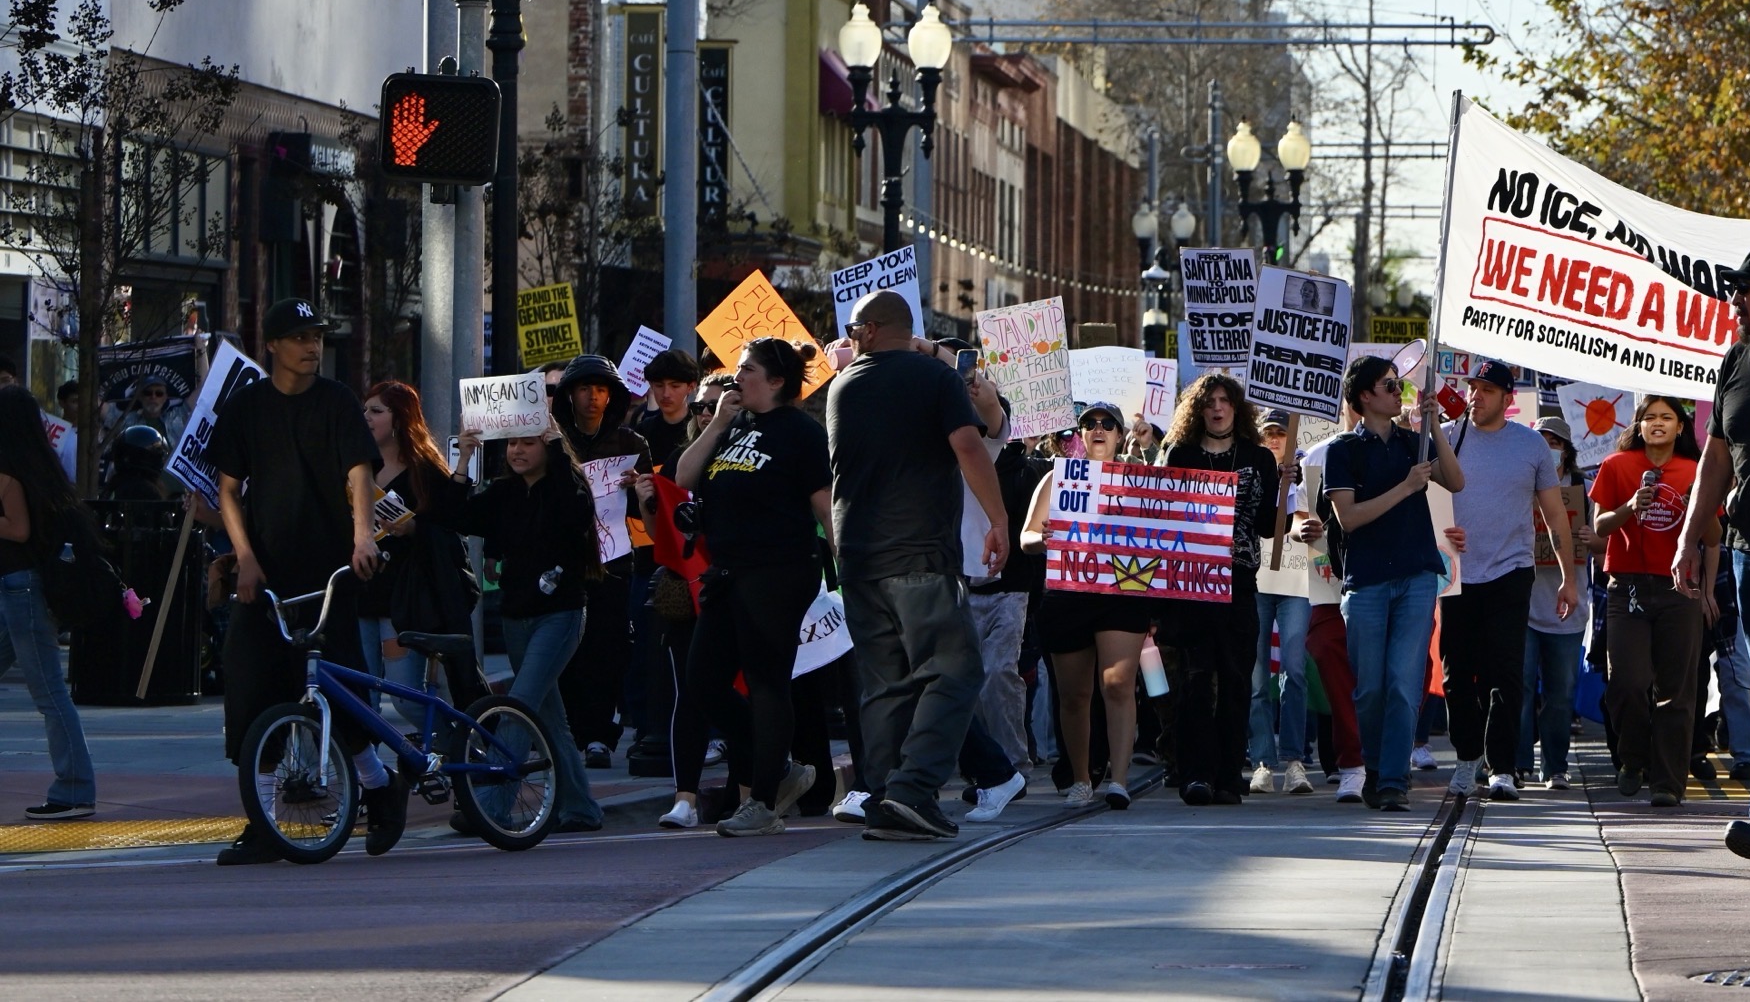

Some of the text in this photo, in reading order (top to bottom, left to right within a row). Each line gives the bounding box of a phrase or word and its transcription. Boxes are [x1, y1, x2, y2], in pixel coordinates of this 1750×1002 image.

[630, 30, 656, 44] CAFÉ
[1487, 168, 1539, 218] NO
[1540, 183, 1602, 240] ICE,
[834, 246, 913, 287] KEEP YOUR
[1184, 258, 1253, 281] SANTA ANA
[551, 286, 570, 301] THE
[836, 265, 917, 303] CITY CLEAN
[1186, 285, 1255, 304] MINNEAPOLIS
[1481, 239, 1537, 297] WE
[1537, 253, 1634, 320] NEED
[1637, 282, 1665, 333] A
[518, 301, 573, 326] GENERAL
[744, 284, 797, 337] FUCK
[1188, 312, 1253, 328] STOP
[525, 323, 573, 348] STRIKE!
[982, 311, 1039, 350] STAND
[1041, 306, 1063, 342] UP
[1190, 329, 1208, 350] ICE
[1208, 329, 1250, 351] TERRO
[1257, 308, 1348, 349] JUSTICE FOR
[1373, 321, 1426, 337] EXPAND THE
[1462, 306, 1505, 335] PARTY
[1506, 317, 1535, 341] FOR
[1537, 324, 1618, 361] SOCIALISM
[1620, 348, 1655, 372] AND
[1011, 343, 1034, 360] FOR
[1254, 341, 1344, 375] RENEE
[154, 364, 190, 396] PREVENT
[987, 363, 1020, 386] YOUR
[1145, 361, 1176, 383] OT
[1251, 360, 1341, 400] NICOLE GOOD
[464, 380, 539, 406] INMIGANTS
[1003, 376, 1067, 403] OUR FAMILY
[1250, 387, 1265, 399] PARTY
[1265, 392, 1275, 401] FOR
[1276, 393, 1303, 407] SOCIALISM
[1311, 400, 1336, 415] LIBERATION
[486, 401, 504, 415] ARE
[1016, 411, 1050, 424] FELLOW
[466, 412, 541, 430] HUMAN BEINGS
[1040, 414, 1072, 434] BEINGS
[1064, 459, 1090, 481] ICE
[1179, 472, 1236, 497] AMERICA
[1058, 490, 1090, 513] OUT
[1103, 494, 1221, 525] IS NOT OUR
[1066, 521, 1188, 553] AMERICA
[1060, 550, 1100, 585] NO
[1166, 559, 1232, 596] KINGS
